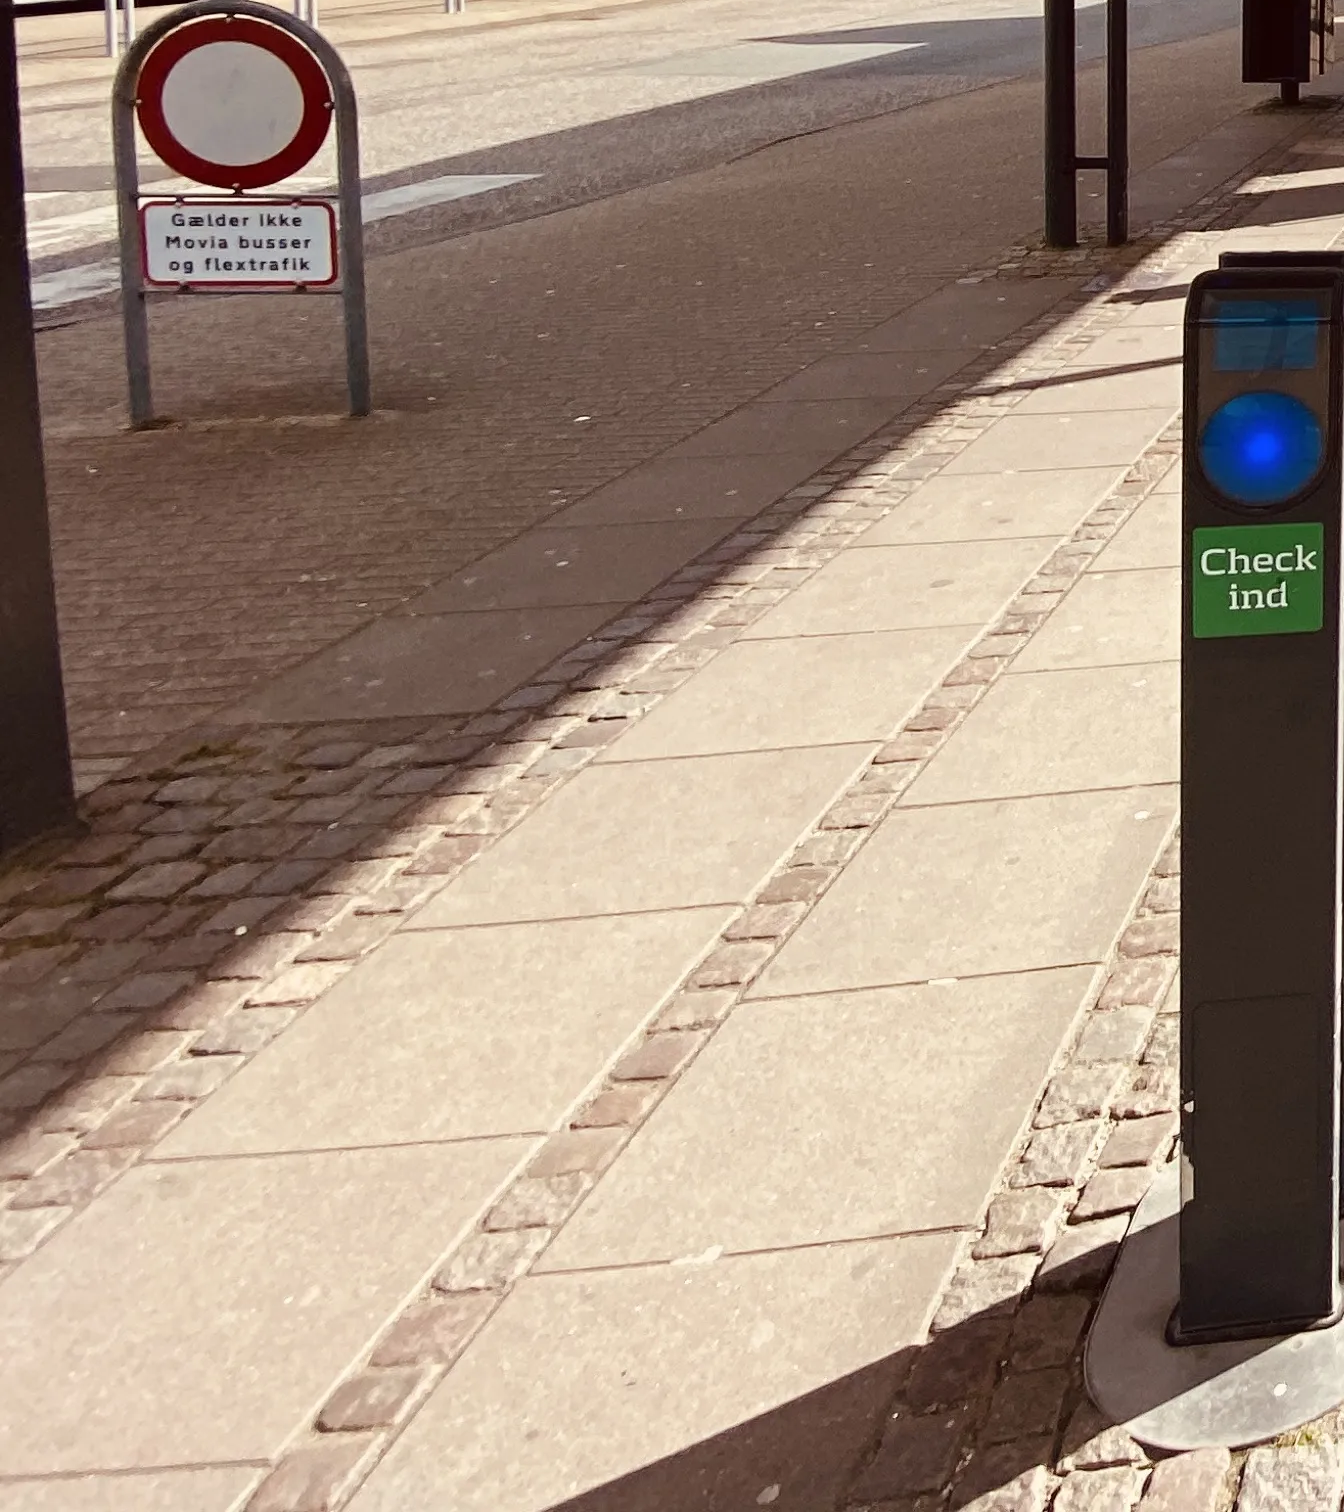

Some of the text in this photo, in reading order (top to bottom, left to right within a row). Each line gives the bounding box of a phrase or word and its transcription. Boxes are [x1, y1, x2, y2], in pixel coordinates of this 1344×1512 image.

[172, 213, 249, 227] Gælder
[165, 236, 311, 250] Movia busser
[169, 258, 311, 274] og flextrafik
[1201, 544, 1317, 576] Check
[1229, 581, 1288, 610] ind
